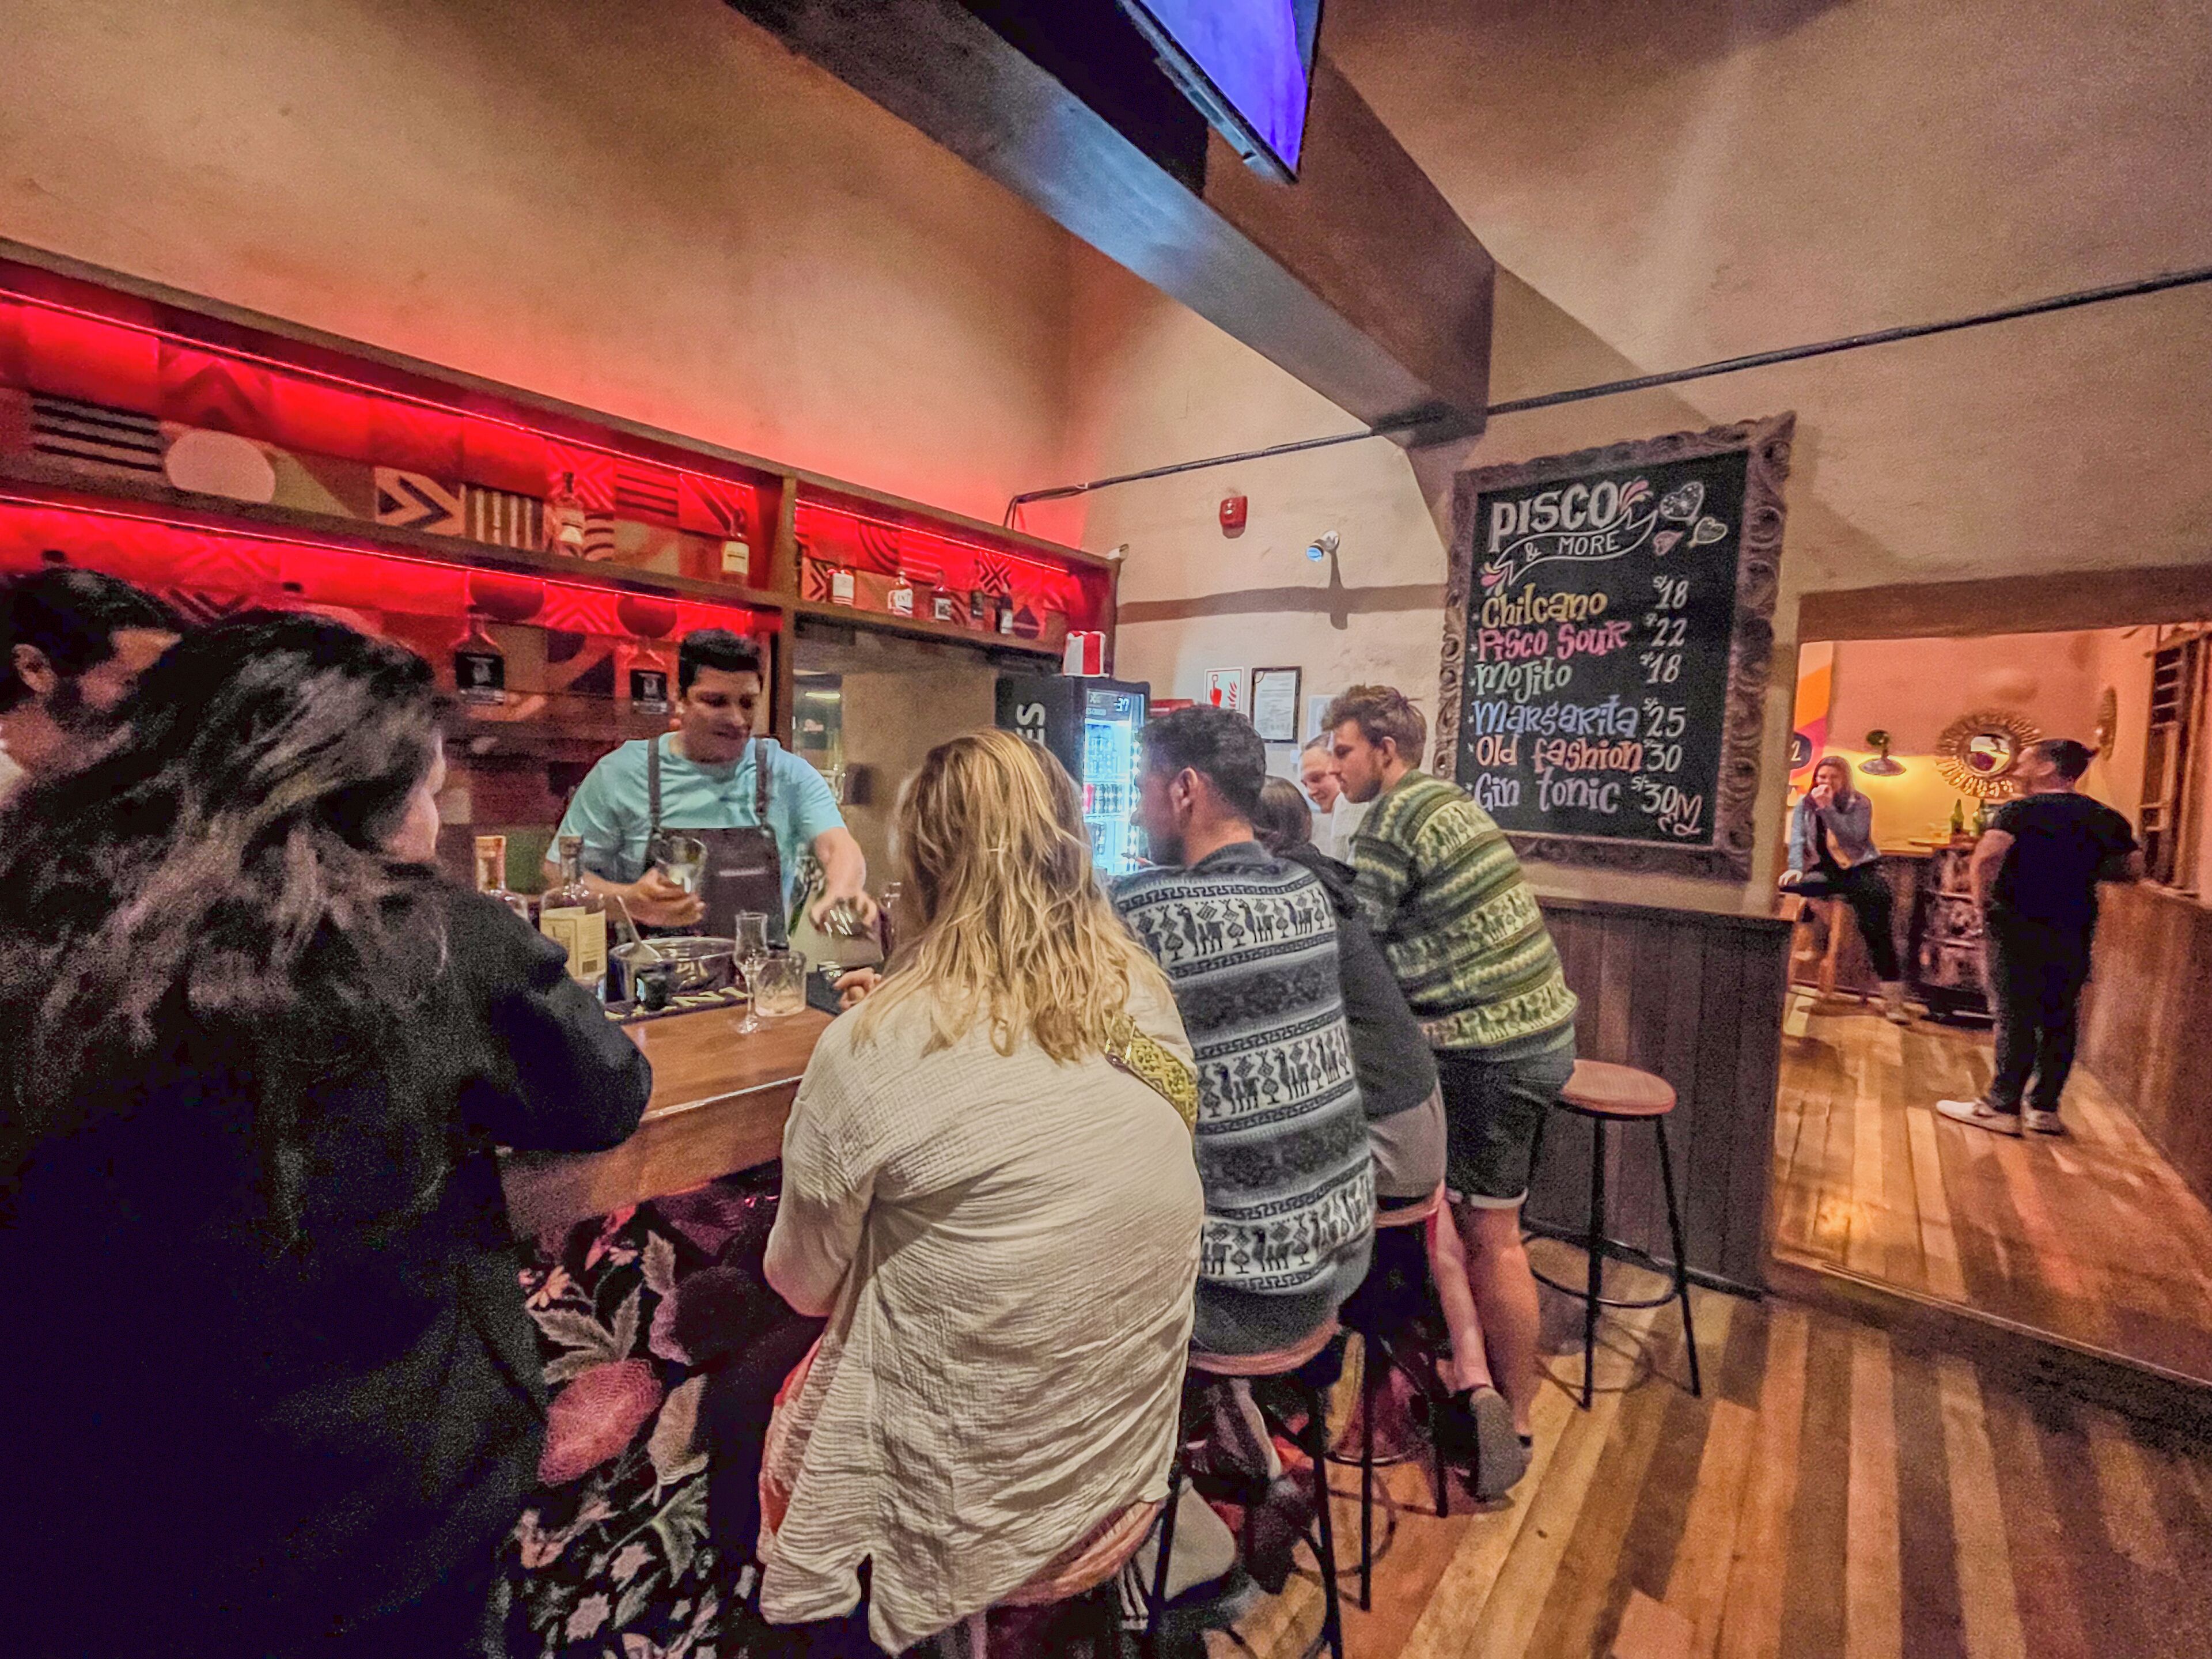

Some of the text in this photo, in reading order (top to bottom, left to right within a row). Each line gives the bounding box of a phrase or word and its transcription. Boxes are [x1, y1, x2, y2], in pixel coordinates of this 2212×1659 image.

[1488, 480, 1619, 552] PISCO
[1525, 531, 1620, 562] & MORE
[1482, 582, 1608, 628] Chilcano
[1016, 702, 1046, 747] ES
[1476, 734, 1520, 766] Old
[1474, 772, 1520, 812] Gin
[1535, 766, 1622, 813] tonic
